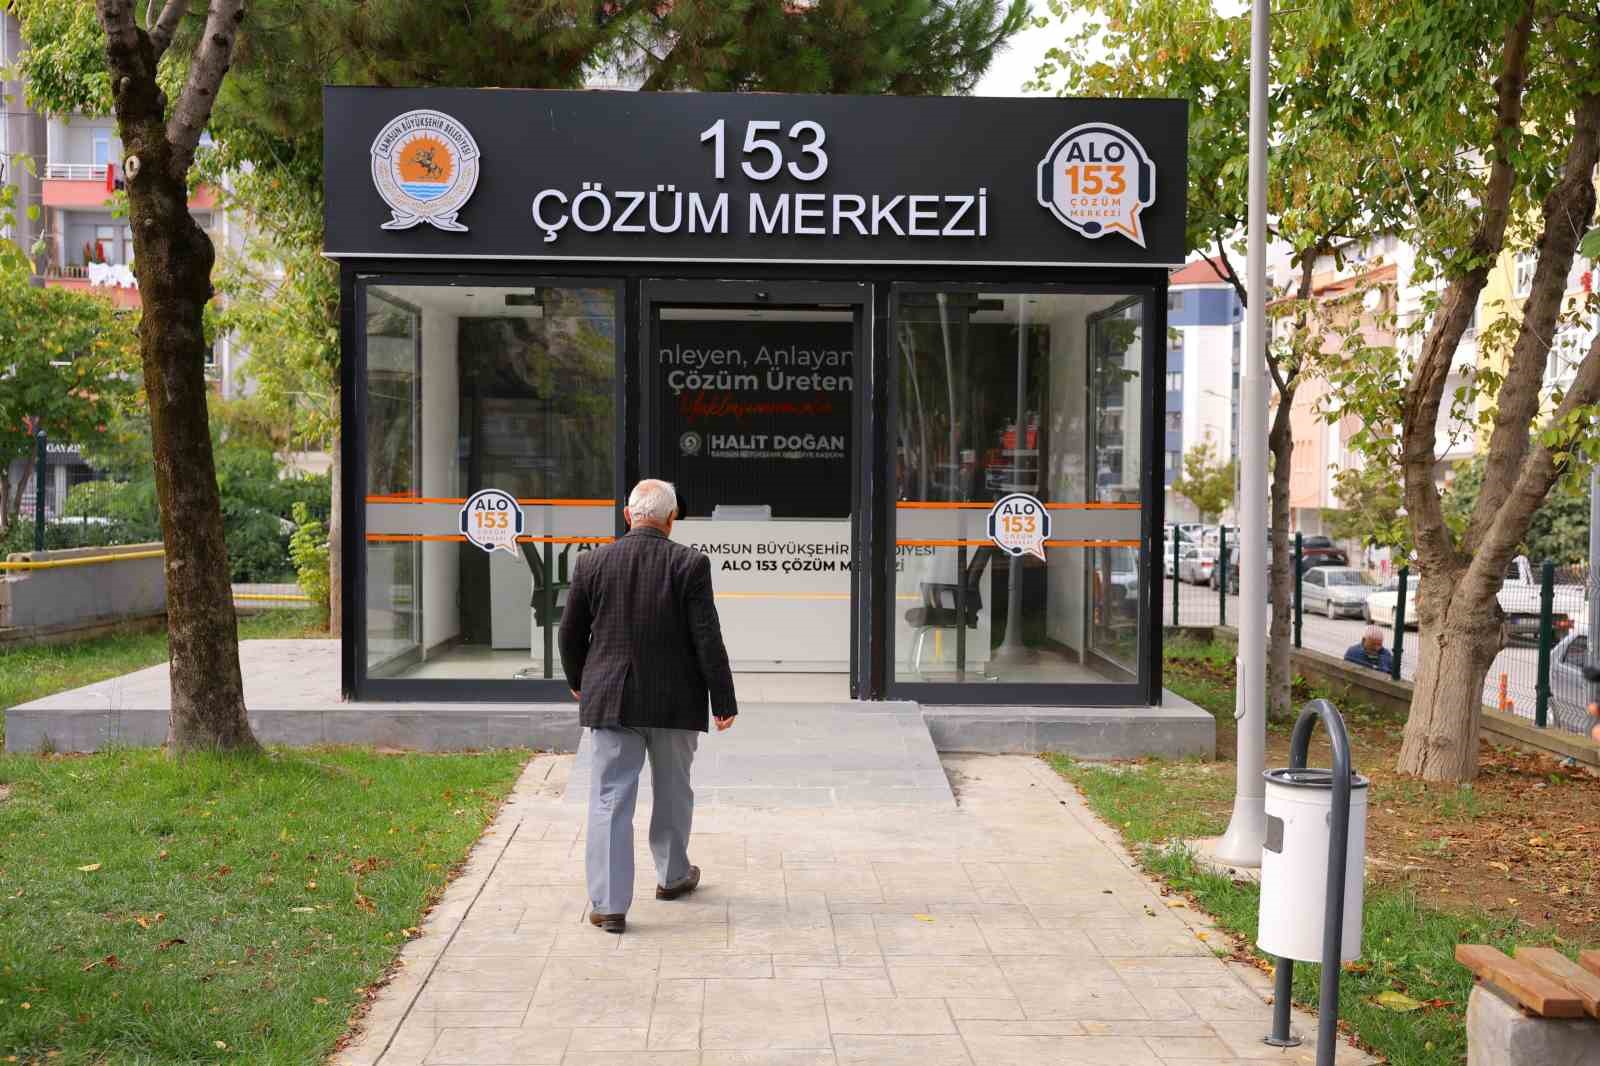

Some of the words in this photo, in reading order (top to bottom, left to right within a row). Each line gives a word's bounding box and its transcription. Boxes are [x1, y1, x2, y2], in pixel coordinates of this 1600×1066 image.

[700, 118, 829, 181] 153
[1065, 141, 1125, 162] ALO
[1065, 164, 1127, 195] 153
[531, 182, 729, 242] ÇÖZÜM
[749, 187, 988, 237] MERKEZİ
[668, 369, 759, 395] Çözüm
[766, 366, 853, 392] Üreten
[773, 432, 845, 450] DOĞAN
[475, 499, 509, 511] ALO
[1002, 503, 1035, 515] ALO
[474, 511, 509, 529] 153
[1002, 516, 1036, 533] 153
[690, 543, 752, 555] SAMSUN
[757, 540, 850, 557] BÜYÜKŞEHİR
[721, 560, 751, 571] ALO
[756, 560, 777, 571] 153
[782, 558, 836, 574] ÇÖZÜM
